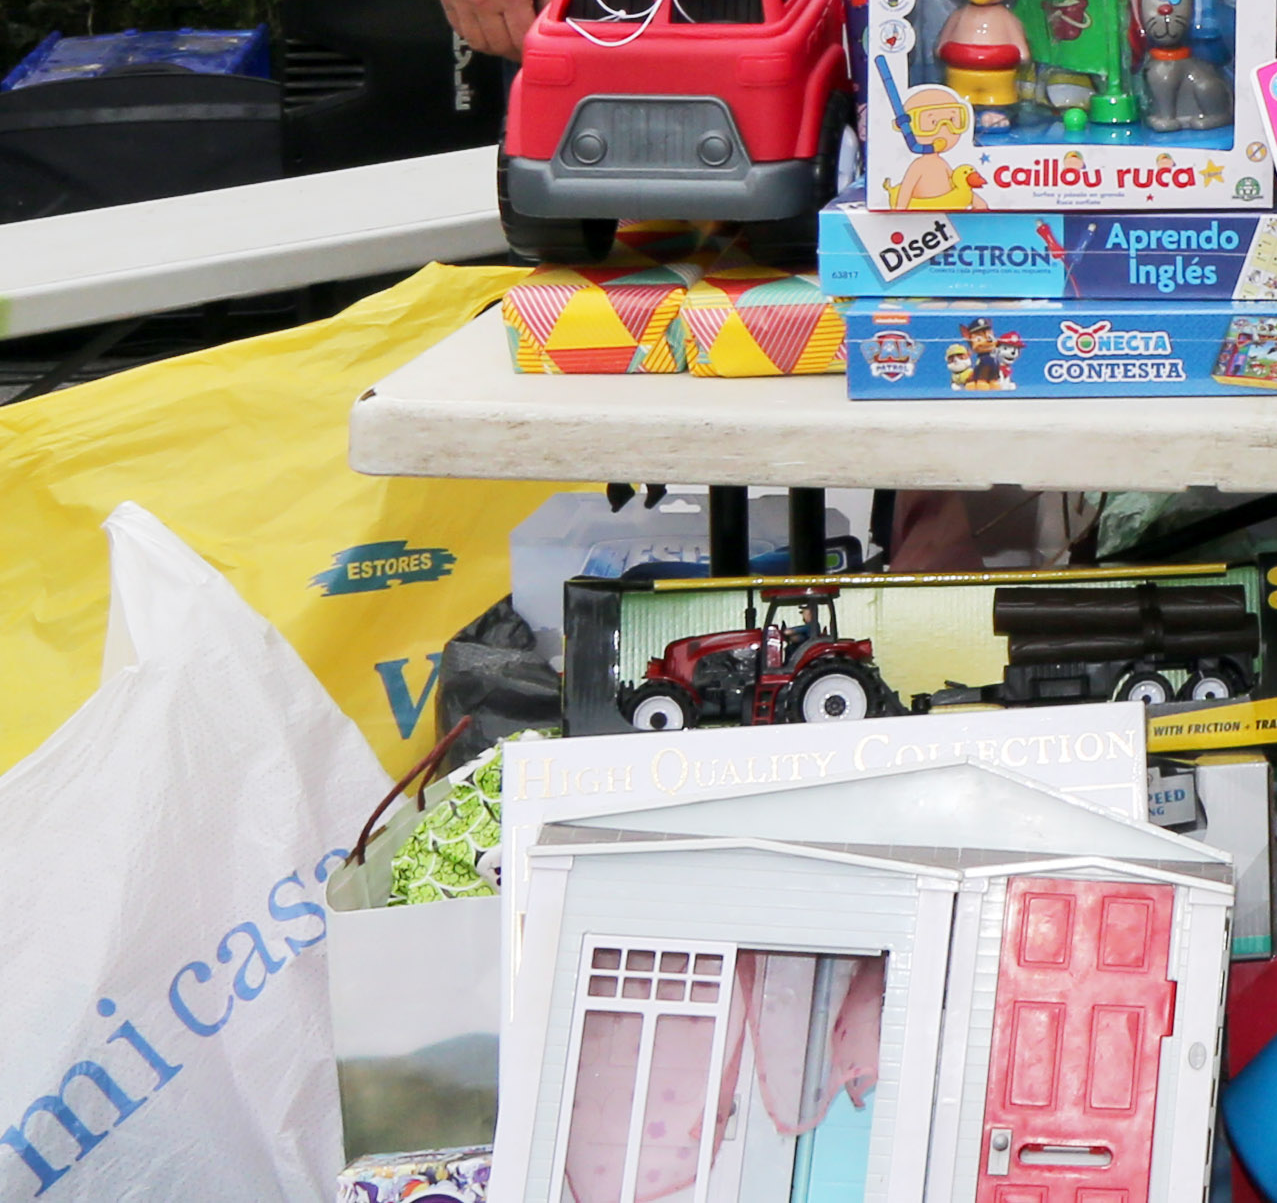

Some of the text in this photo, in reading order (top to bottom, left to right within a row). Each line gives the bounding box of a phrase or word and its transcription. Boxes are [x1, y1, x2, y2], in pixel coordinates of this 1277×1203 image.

[993, 159, 1195, 188] caillou ruca
[878, 219, 951, 273] Diset
[929, 244, 1051, 267] LECTRON
[1105, 221, 1239, 263] Aprendo
[832, 271, 859, 279] 63817
[1129, 257, 1218, 293] Inglés
[1060, 328, 1171, 355] CONECTA
[1047, 361, 1183, 381] CONTESTA
[347, 551, 434, 580] ESTORES
[1153, 724, 1183, 738] WITH
[1186, 720, 1241, 735] FRICTION
[651, 746, 833, 798] QUALITY
